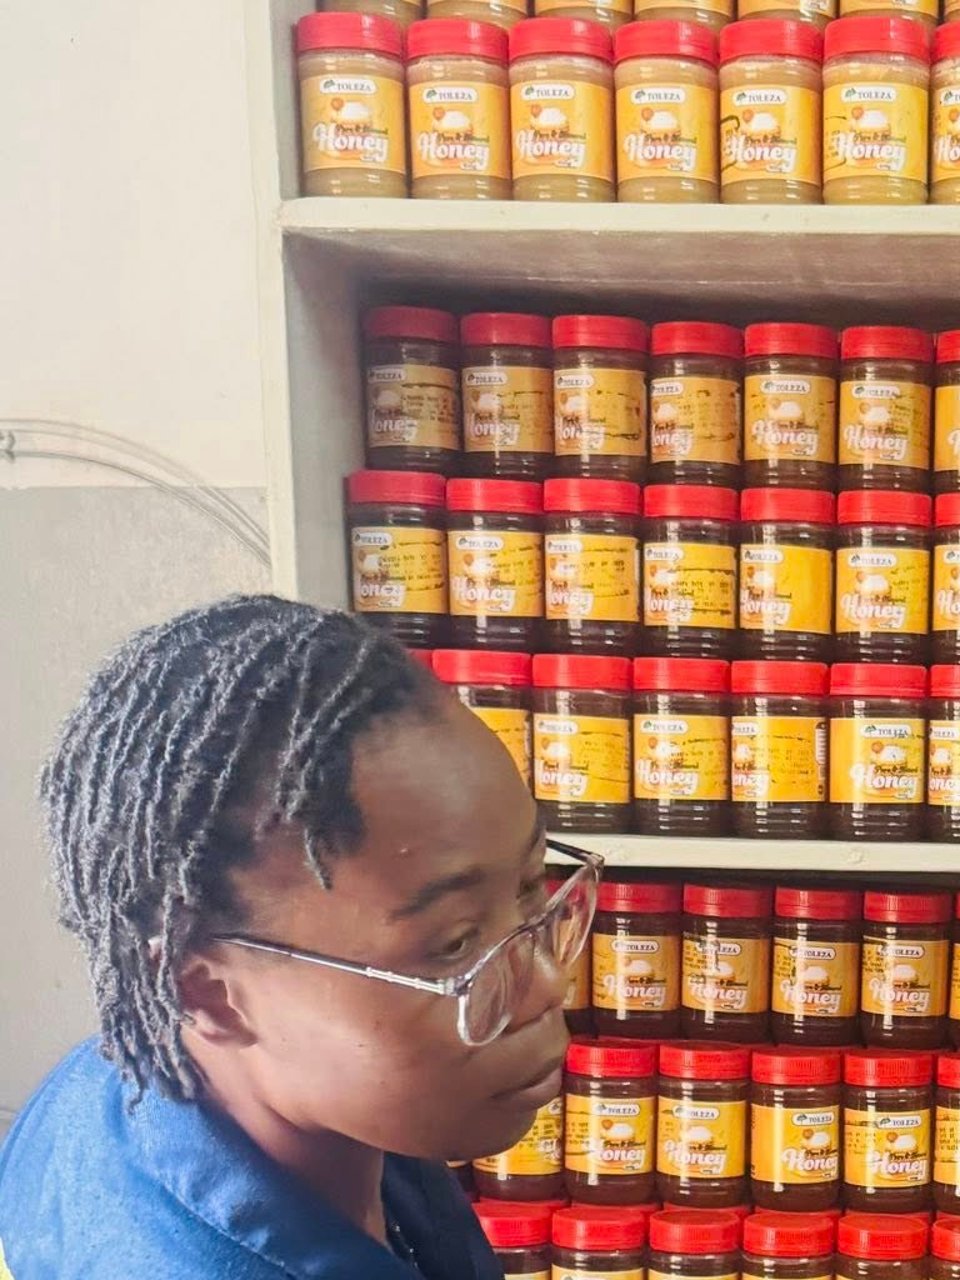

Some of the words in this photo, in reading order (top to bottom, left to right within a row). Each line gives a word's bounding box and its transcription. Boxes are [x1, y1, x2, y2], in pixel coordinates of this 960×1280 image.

[336, 82, 372, 92] TOLEZA
[439, 92, 472, 100] TOLEZA
[536, 89, 568, 97] TOLEZA
[646, 90, 681, 101] TOLEZA
[748, 92, 781, 102] TOLEZA
[857, 90, 892, 99] TOLEZA
[313, 122, 388, 162] Honey
[419, 132, 489, 169] Honey
[517, 131, 585, 166] Honey
[624, 133, 696, 170] Honey
[734, 134, 797, 171] Honey
[838, 132, 907, 170] Honey
[752, 421, 818, 454] Honey
[846, 425, 908, 458] Honey
[452, 575, 515, 611] Honey
[841, 594, 906, 627] Honey
[639, 759, 698, 793] Honey
[851, 763, 917, 797] Honey
[603, 975, 665, 1008] Honey
[870, 979, 929, 1012] Honey
[668, 1141, 726, 1175] Honey
[868, 1152, 926, 1182] Honey
